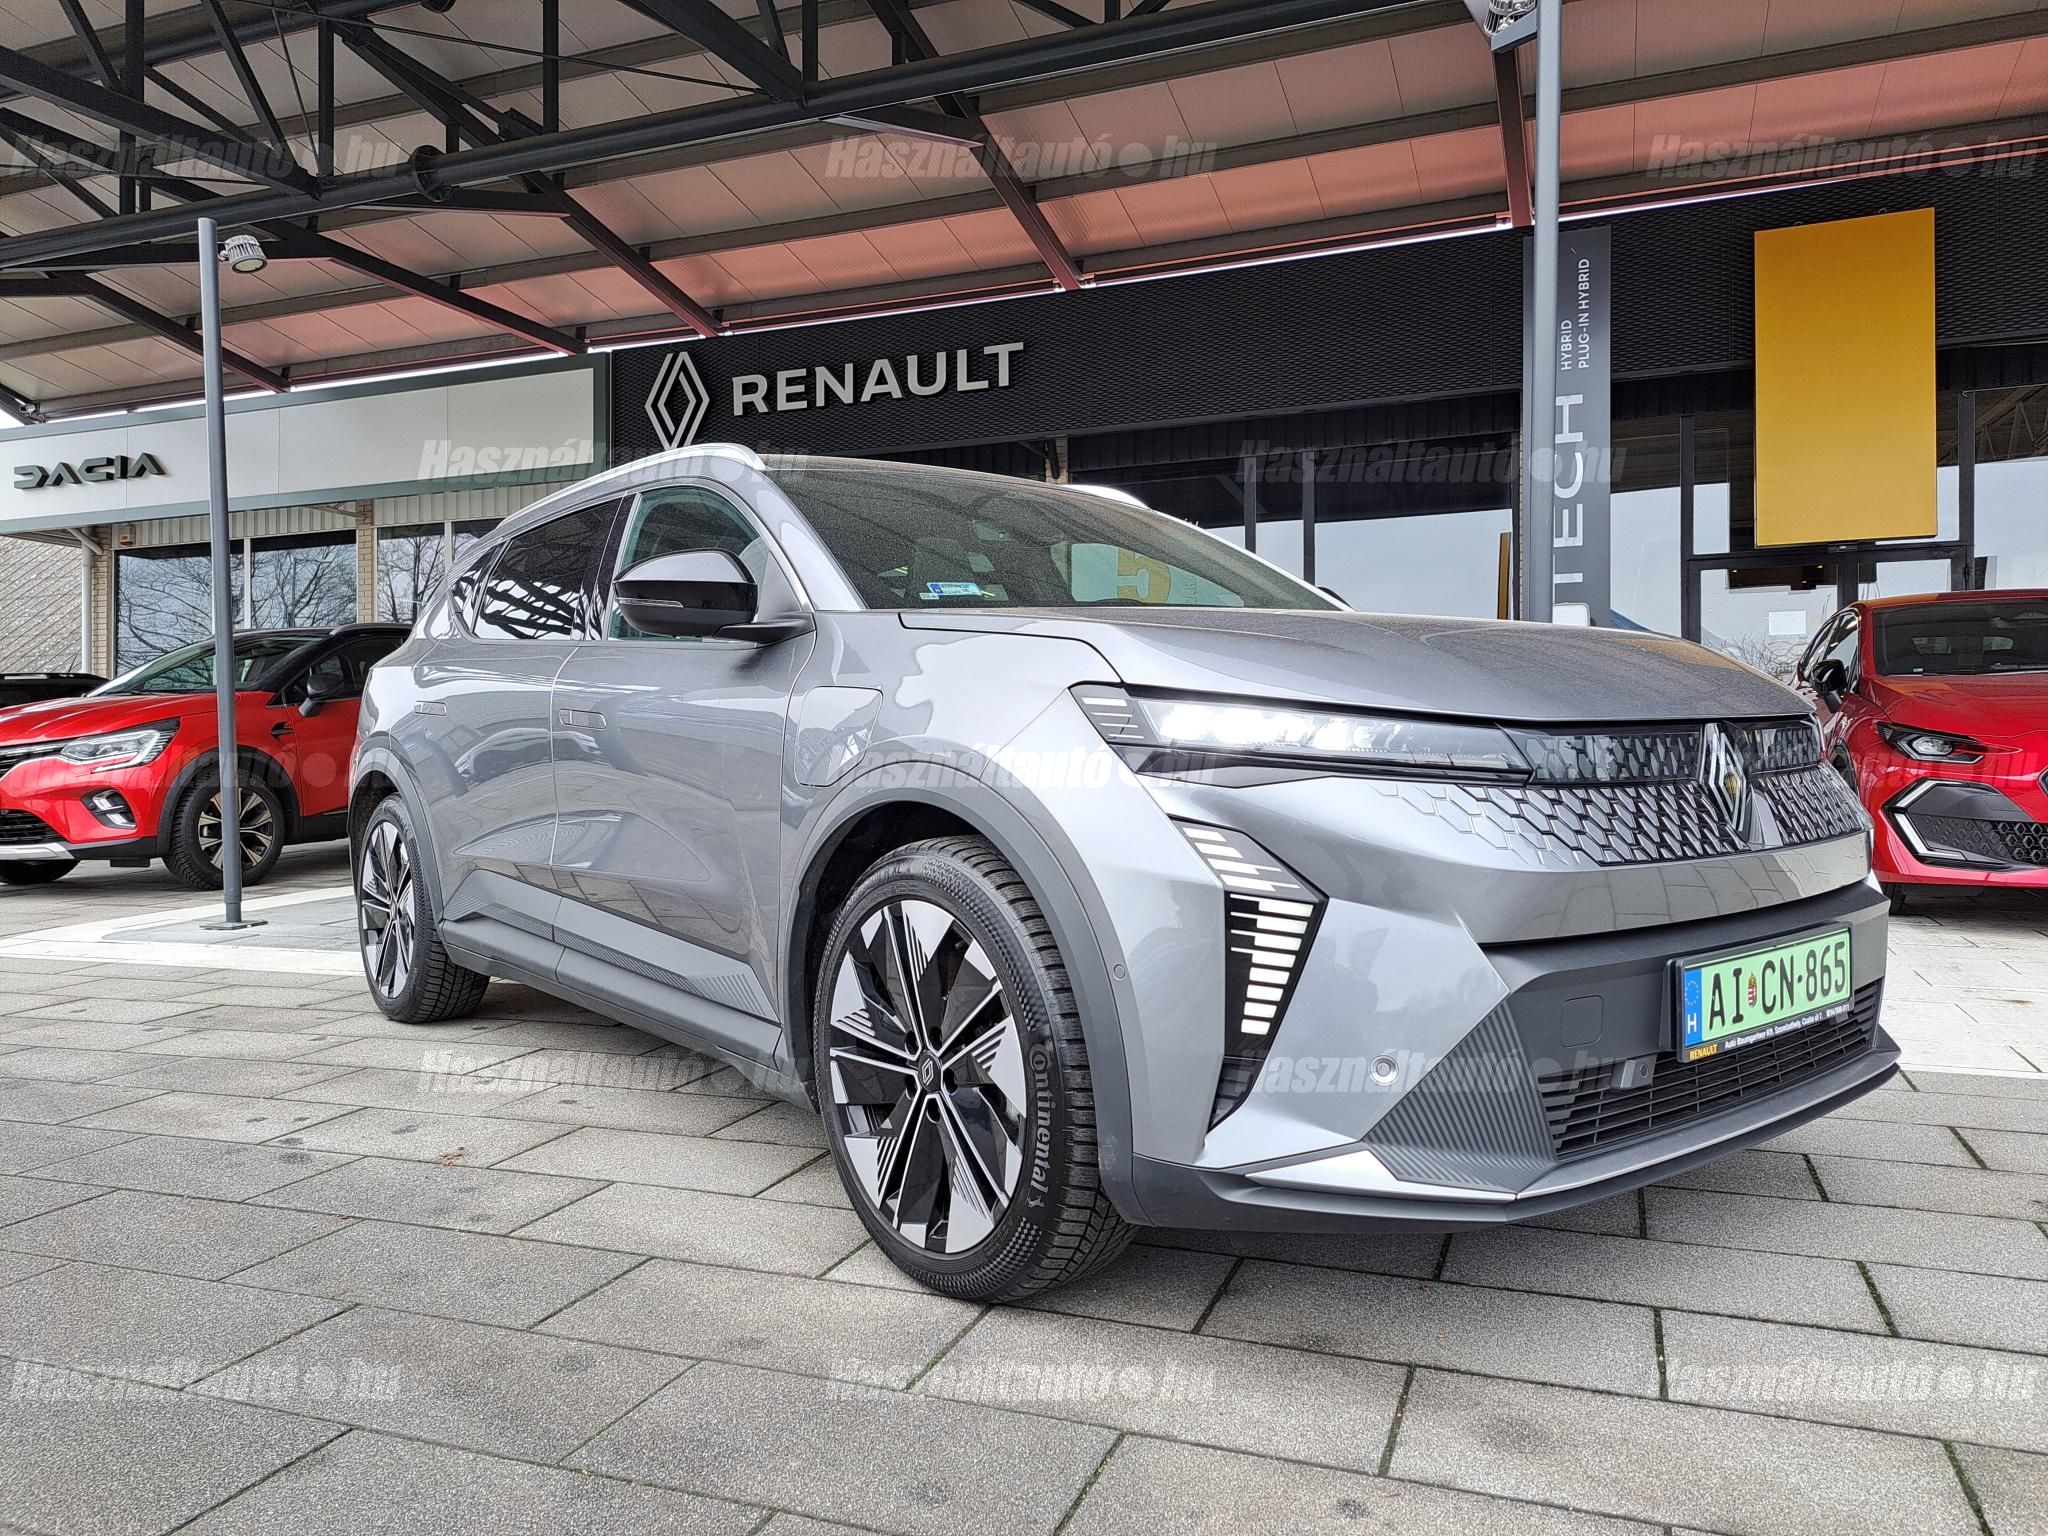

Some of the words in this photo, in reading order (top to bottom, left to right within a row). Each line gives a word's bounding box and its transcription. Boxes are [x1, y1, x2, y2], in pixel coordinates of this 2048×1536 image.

[1578, 258, 1590, 309] HYBRID
[1560, 319, 1572, 370] HYBRID
[1578, 312, 1590, 368] PLUG-IN
[732, 341, 1025, 417] RENAULT
[13, 452, 166, 490] DACIA
[1687, 1013, 1697, 1034] H
[1708, 967, 1744, 1031] AI
[1690, 1044, 1718, 1060] RENAULT
[1029, 1043, 1057, 1196] Continental
